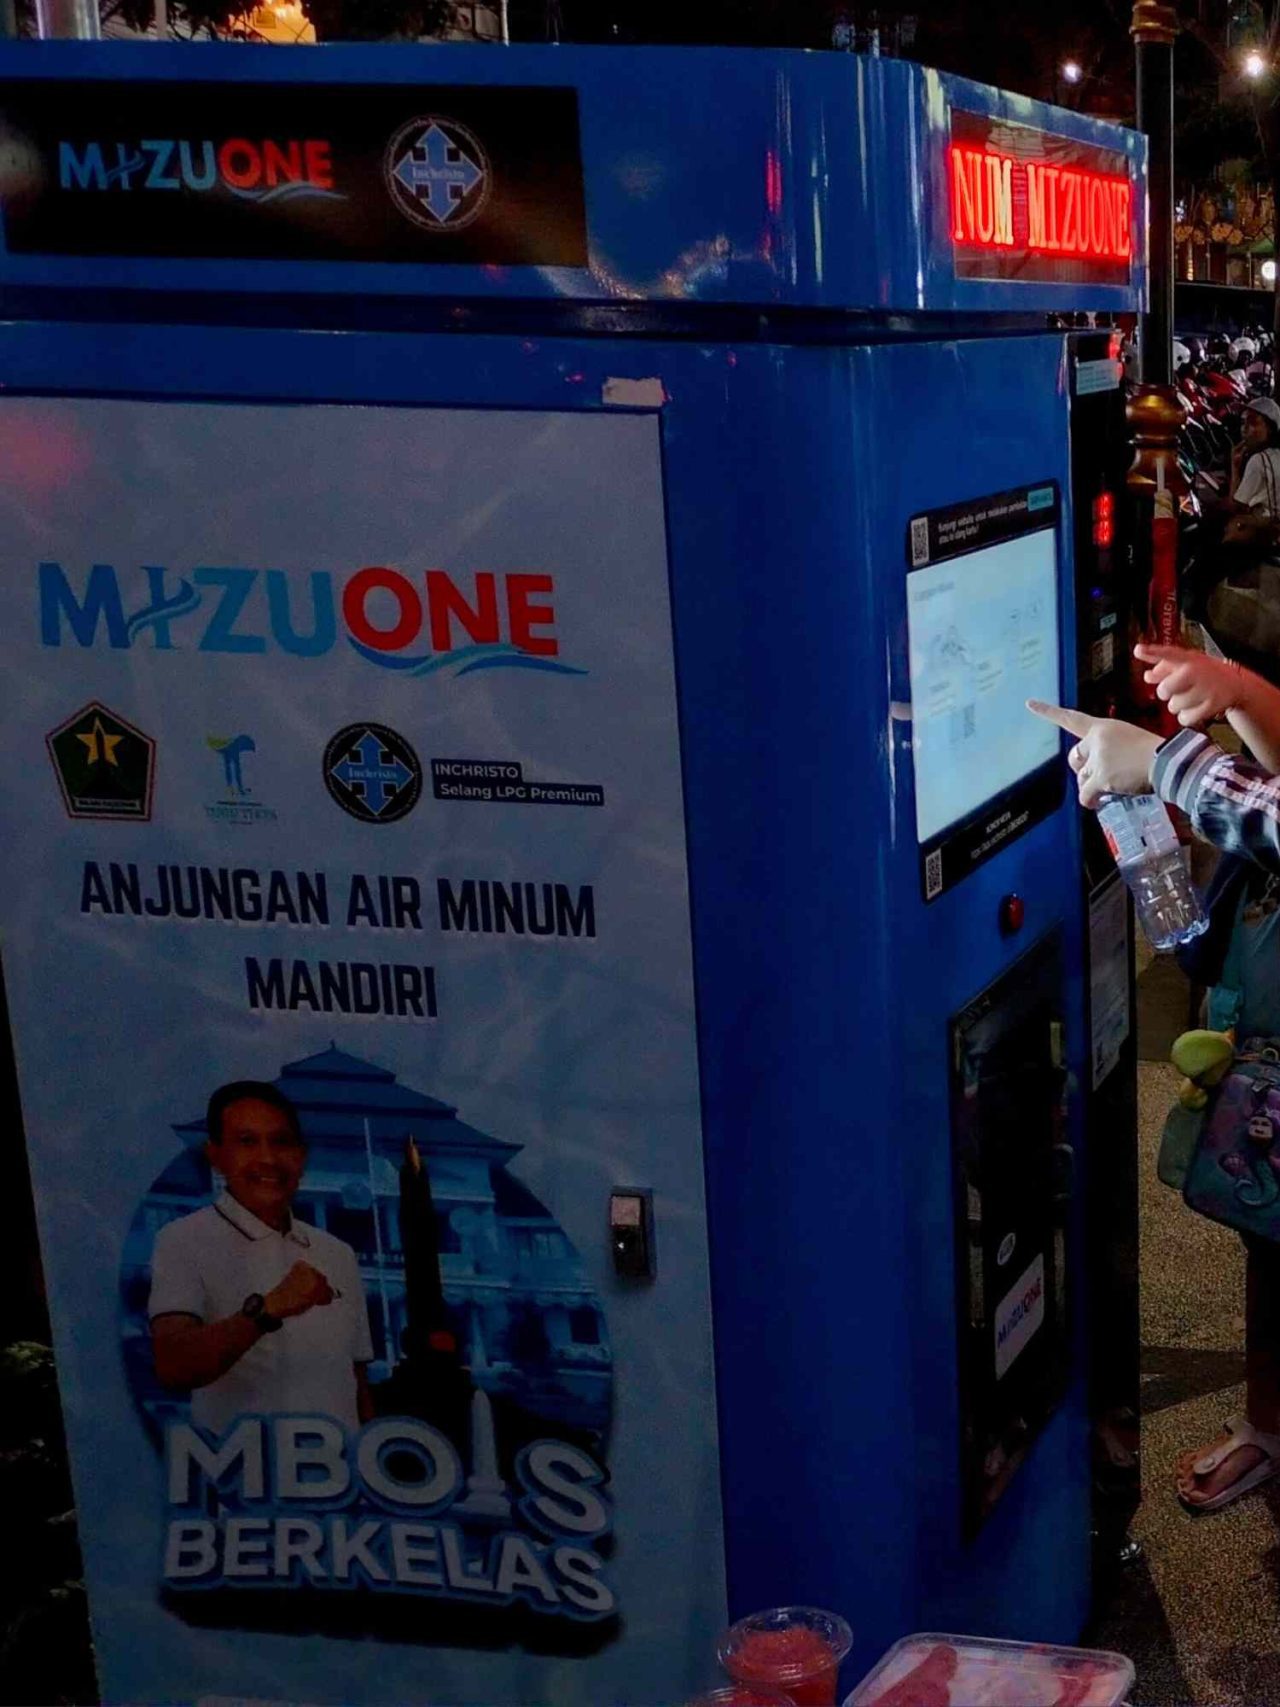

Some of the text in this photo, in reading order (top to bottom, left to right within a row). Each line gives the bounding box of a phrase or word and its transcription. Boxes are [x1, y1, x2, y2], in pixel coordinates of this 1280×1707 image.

[58, 137, 335, 191] MIZUONE
[952, 149, 1130, 257] NUM MIZUONE
[38, 562, 560, 657] MIZUONE
[434, 763, 519, 779] INCHRISTO
[440, 783, 601, 802] Selang LPG Premium
[80, 860, 598, 938] ANJUNGAN AIR MINUM
[244, 956, 439, 1018] MANDIRI
[164, 1517, 616, 1613] BERKELAS
